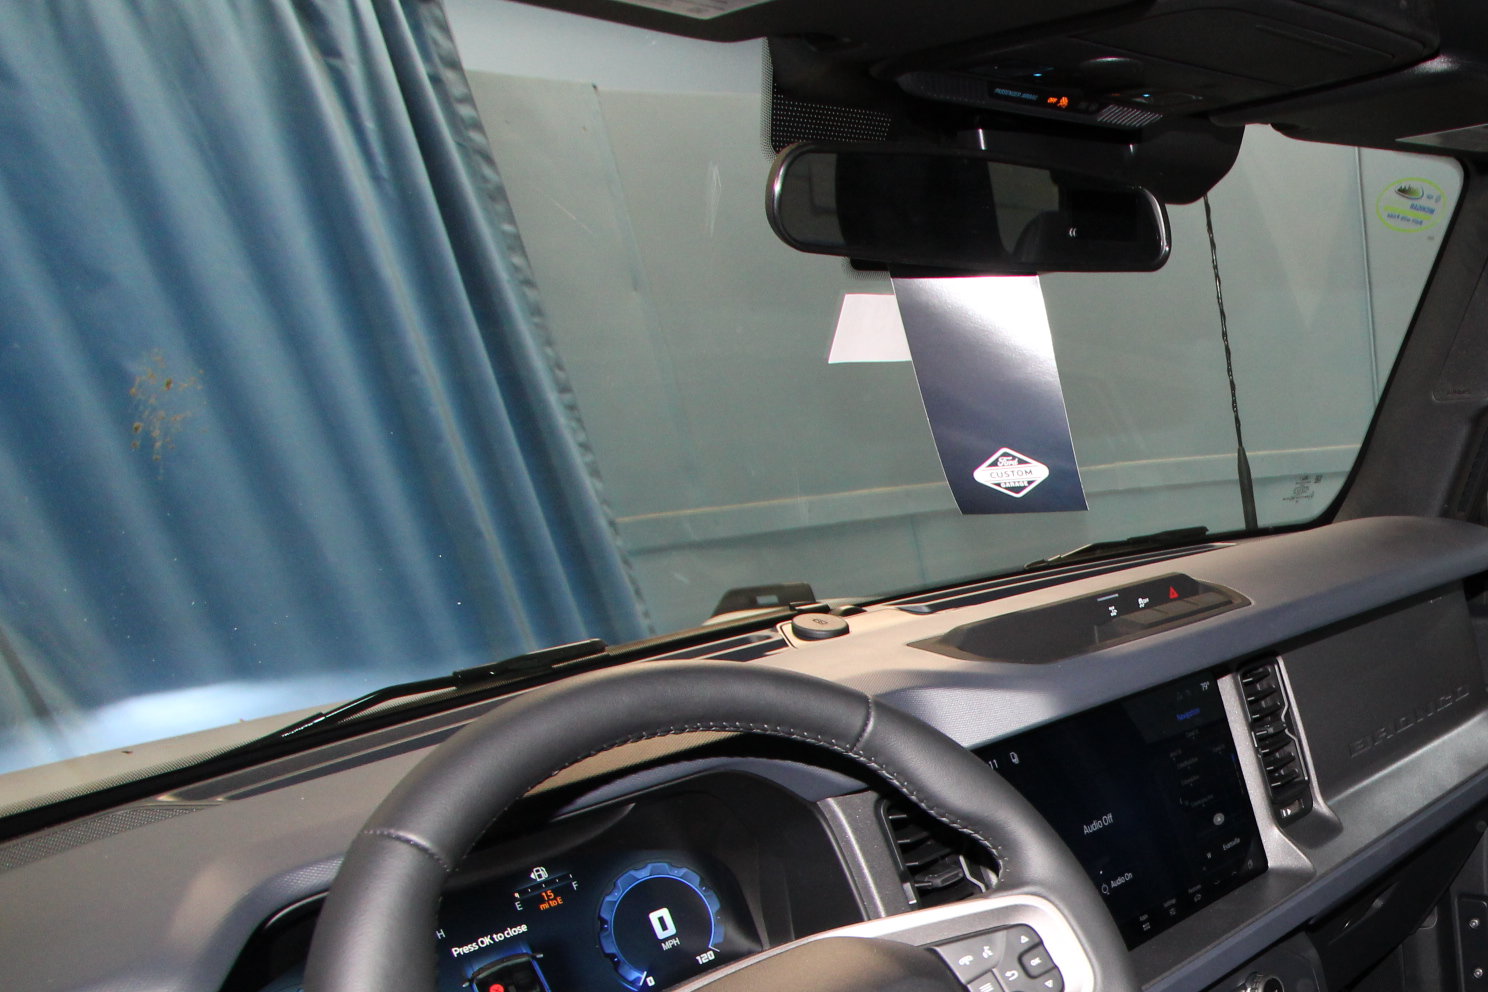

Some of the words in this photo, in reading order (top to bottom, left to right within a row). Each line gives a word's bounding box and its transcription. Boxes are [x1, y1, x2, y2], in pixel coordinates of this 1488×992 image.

[997, 456, 1018, 467] Ford
[990, 469, 1033, 479] CUSTOM
[1083, 819, 1103, 835] Audio
[1102, 813, 1113, 826] Off
[572, 880, 578, 890] F
[1110, 876, 1125, 888] Audio
[1124, 872, 1133, 881] On
[541, 889, 554, 900] 15
[515, 901, 523, 911] E
[539, 902, 550, 910] mi
[550, 898, 558, 907] to
[648, 907, 677, 940] 0
[451, 942, 479, 958] Press
[477, 934, 495, 948] OK
[493, 931, 505, 942] to
[504, 923, 528, 938] close
[661, 937, 680, 951] MPH
[696, 950, 715, 965] 120
